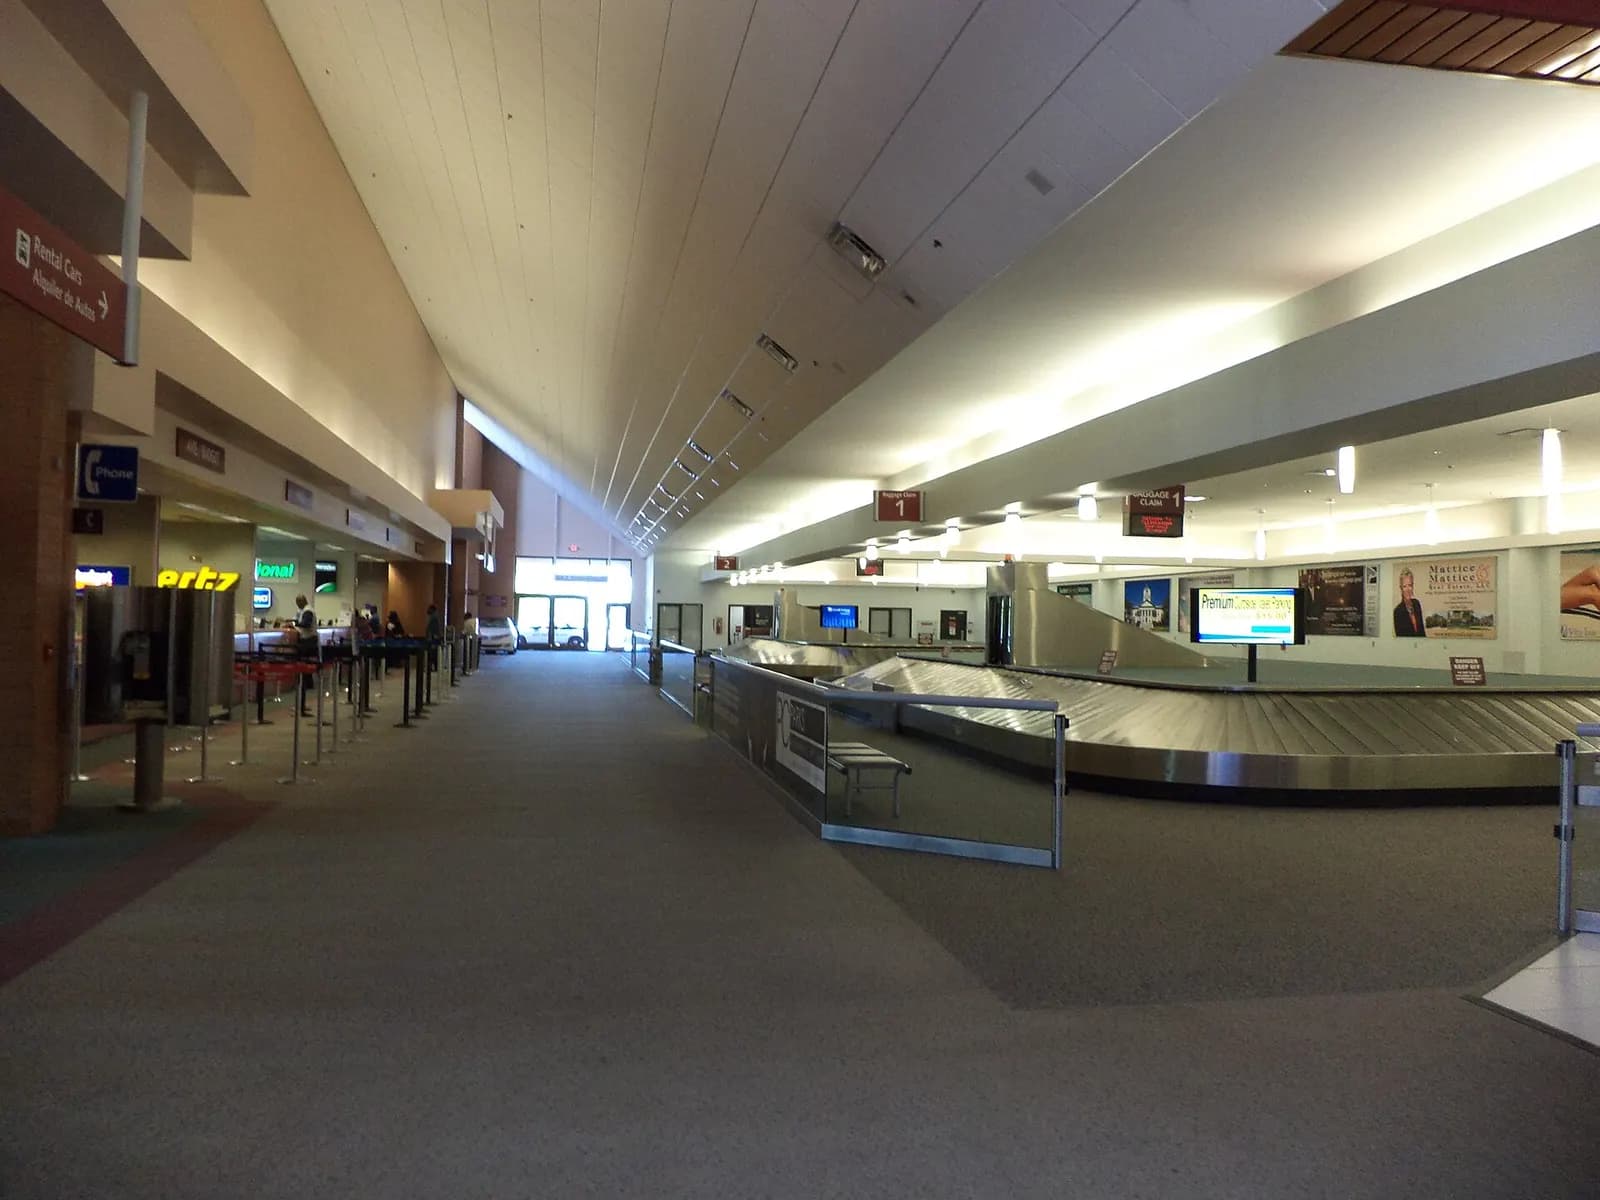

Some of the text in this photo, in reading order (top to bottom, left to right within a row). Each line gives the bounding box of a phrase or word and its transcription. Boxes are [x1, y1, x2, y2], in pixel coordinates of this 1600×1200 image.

[34, 235, 82, 286] Rental Cars
[64, 288, 74, 308] de
[75, 296, 96, 322] Autos
[95, 466, 134, 479] Phone
[1140, 498, 1163, 506] CLAIM
[1173, 492, 1180, 507] 1
[895, 499, 904, 517] 1
[724, 560, 730, 569] 2
[1428, 565, 1476, 574] Mattice
[1428, 574, 1476, 583] Mattice
[1201, 593, 1234, 609] Premium
